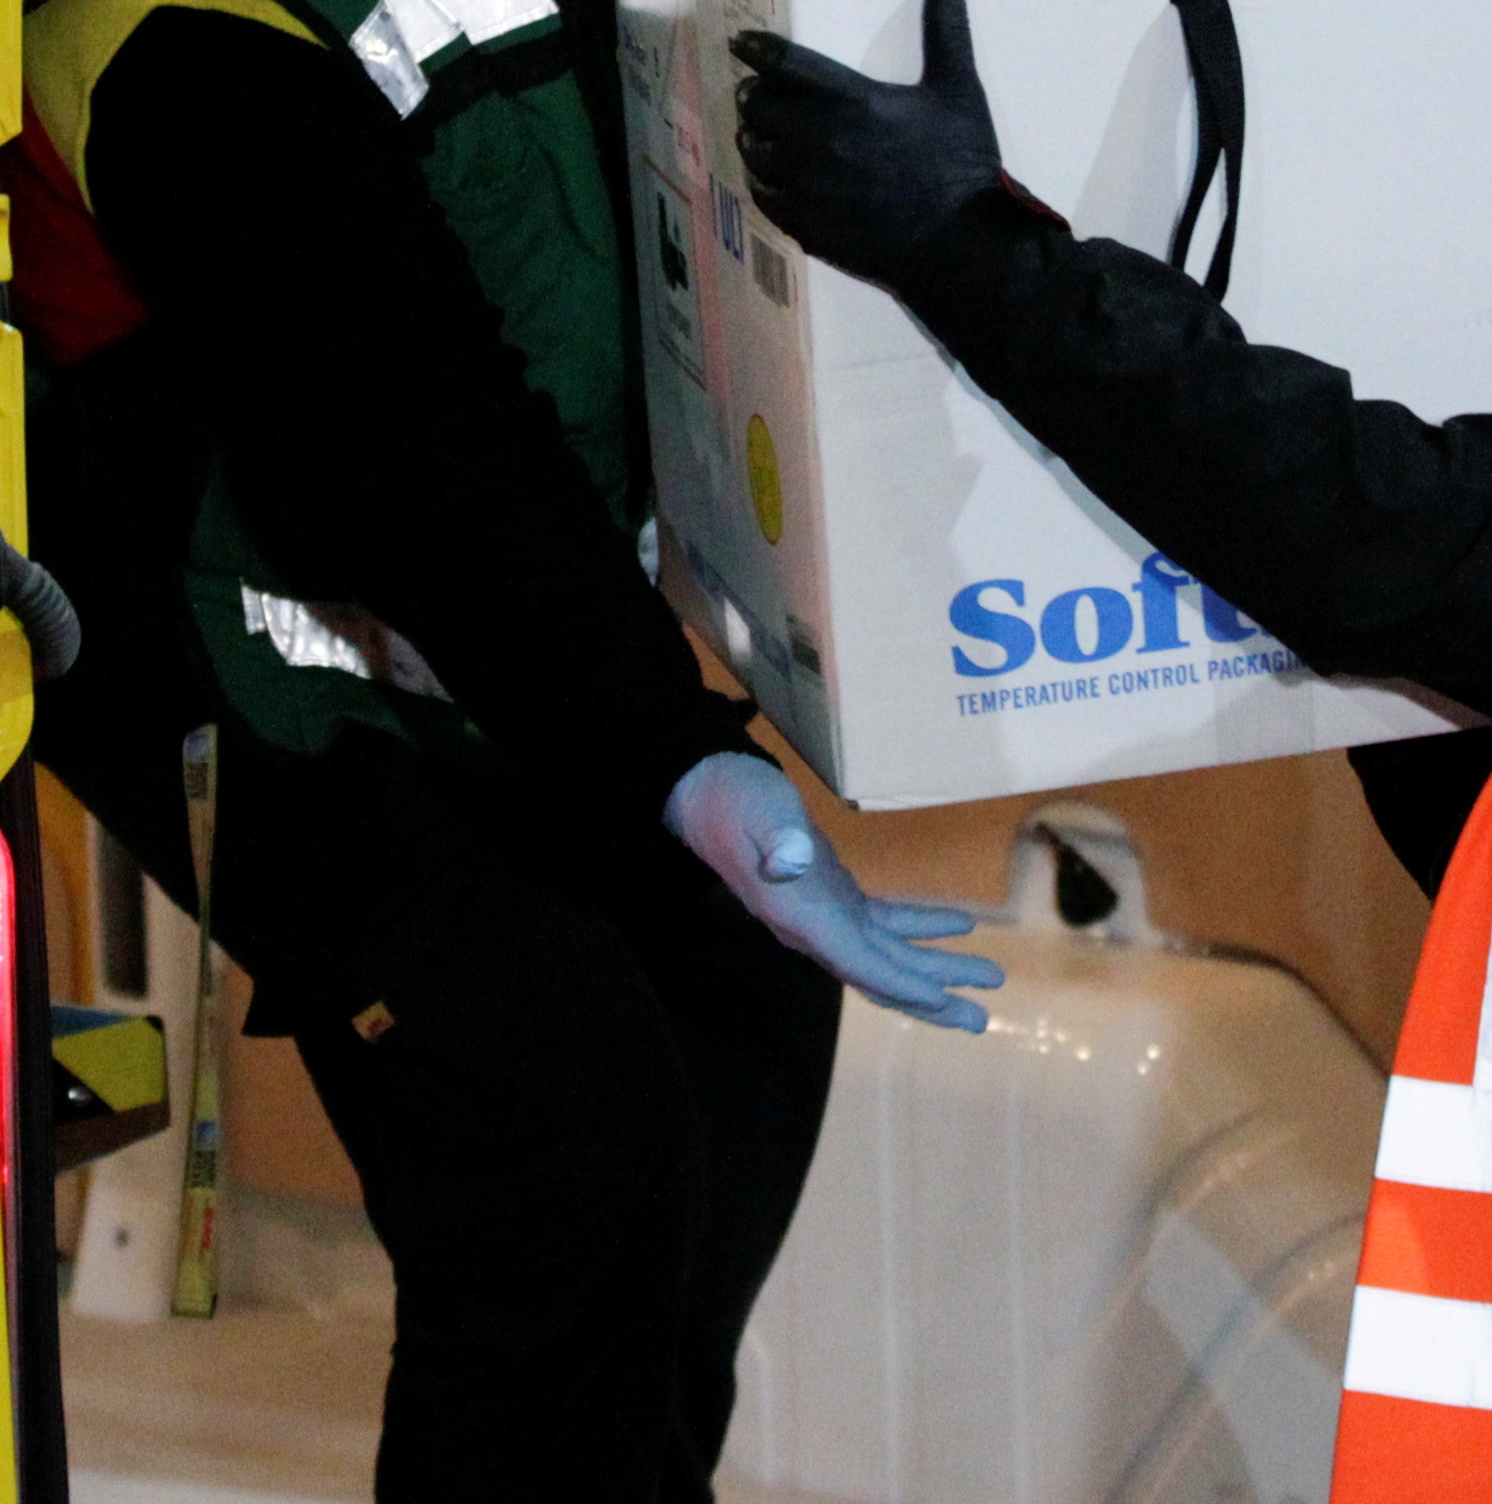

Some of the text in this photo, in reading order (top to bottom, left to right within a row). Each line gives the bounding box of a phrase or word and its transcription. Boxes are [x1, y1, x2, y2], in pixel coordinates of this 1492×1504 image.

[948, 551, 1273, 678] Soft
[956, 676, 1101, 717] TEMPERATURE
[1108, 661, 1201, 695] CONTROL
